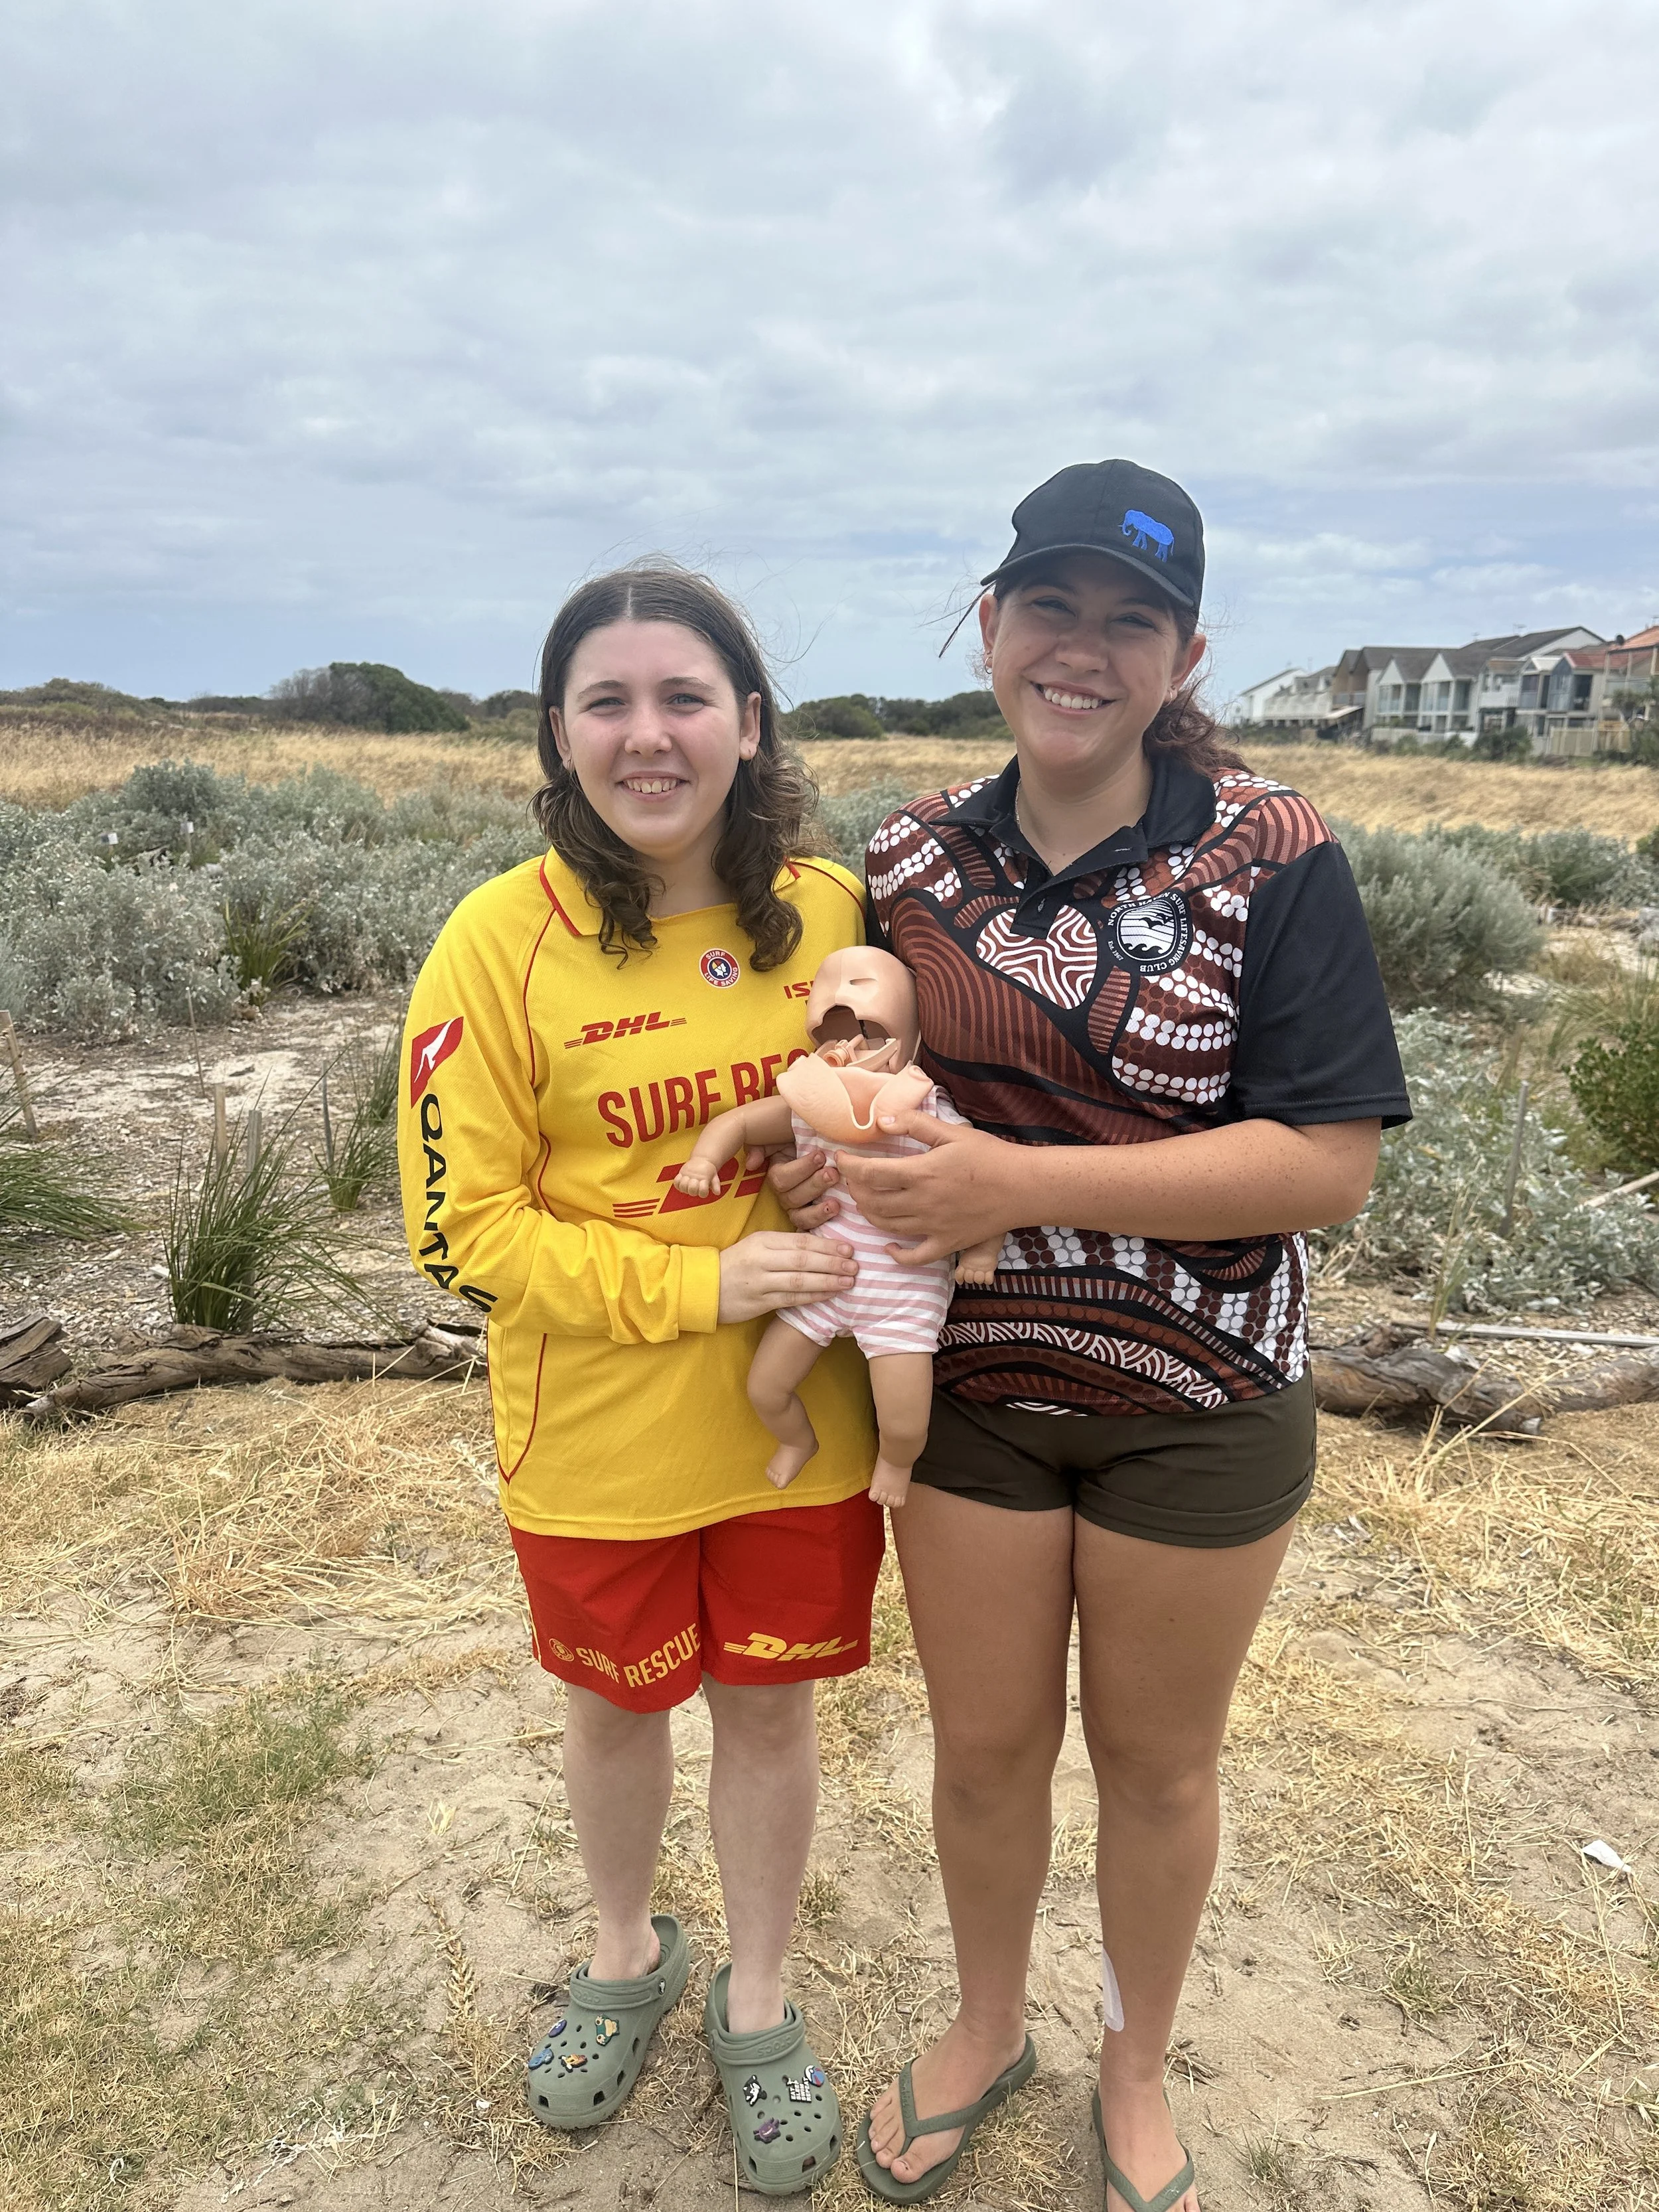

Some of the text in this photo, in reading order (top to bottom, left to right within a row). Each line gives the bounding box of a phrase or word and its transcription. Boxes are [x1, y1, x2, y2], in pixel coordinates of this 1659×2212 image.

[1108, 903, 1136, 926] NORTH
[1170, 893, 1187, 916] SURF
[1168, 917, 1188, 966] LIFESAVING
[705, 950, 725, 960] SURF
[1139, 962, 1167, 972] CLUB
[704, 967, 738, 986] LIFE SAVING
[784, 980, 814, 999] IS
[579, 1011, 672, 1046] DHL
[598, 1069, 721, 1148] SURF
[420, 1093, 498, 1313] QANTAS
[575, 1647, 620, 1684] SURF
[623, 1623, 701, 1688] RESCUE
[742, 1631, 848, 1661] DHL
